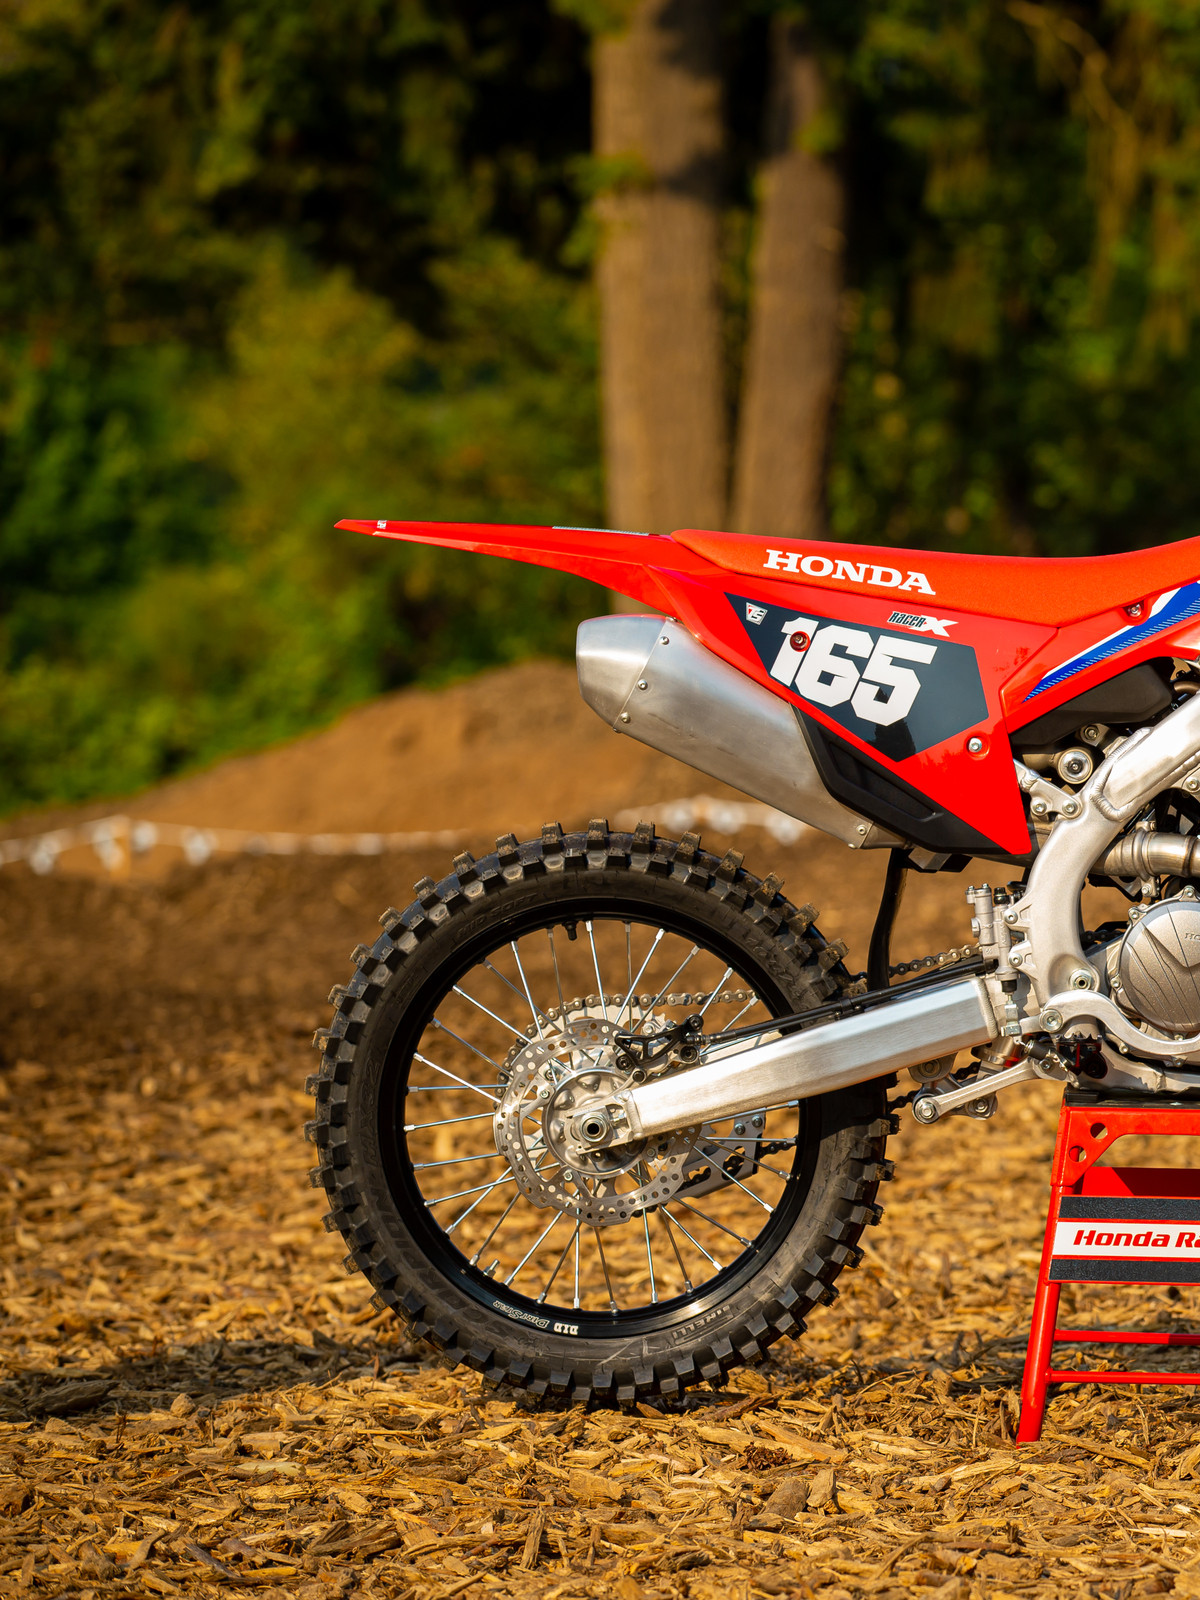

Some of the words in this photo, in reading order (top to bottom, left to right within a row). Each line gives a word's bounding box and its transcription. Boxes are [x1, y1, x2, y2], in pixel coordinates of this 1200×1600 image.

[763, 549, 936, 595] HONDA
[888, 611, 927, 628] RACER
[770, 616, 938, 726] 165
[1073, 1229, 1170, 1248] Honda
[368, 1181, 512, 1341] SCORPION
[671, 1304, 734, 1345] PIRELLI
